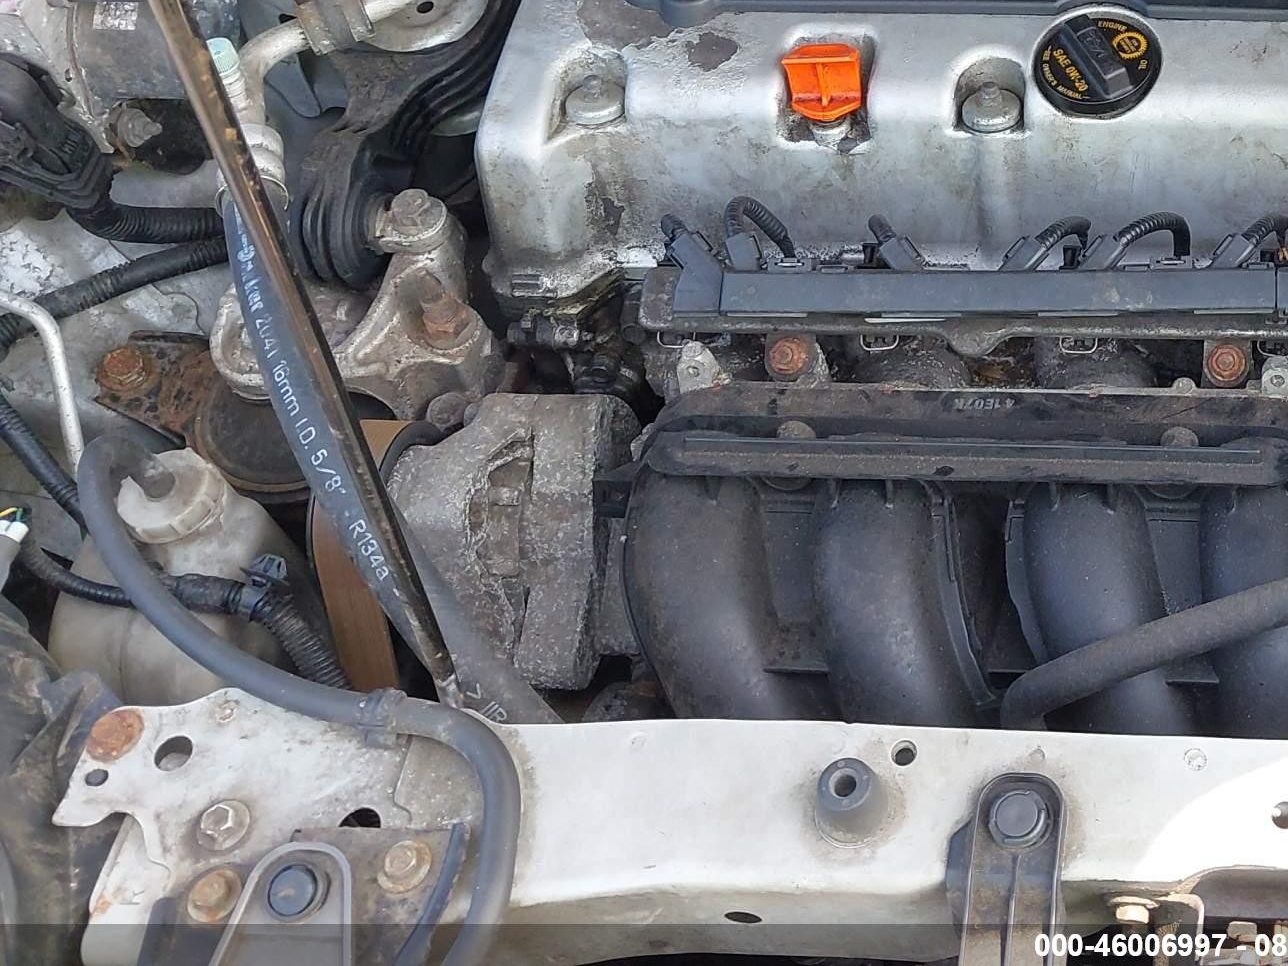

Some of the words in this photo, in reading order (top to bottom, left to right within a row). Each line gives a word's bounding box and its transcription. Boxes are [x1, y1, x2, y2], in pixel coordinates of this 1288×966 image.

[1098, 21, 1127, 32] ENGINE
[1053, 48, 1073, 68] SAE
[1065, 66, 1089, 92] 0W-20
[1138, 59, 1148, 70] OIL
[272, 360, 301, 417] 16mm
[348, 519, 390, 583] R134a
